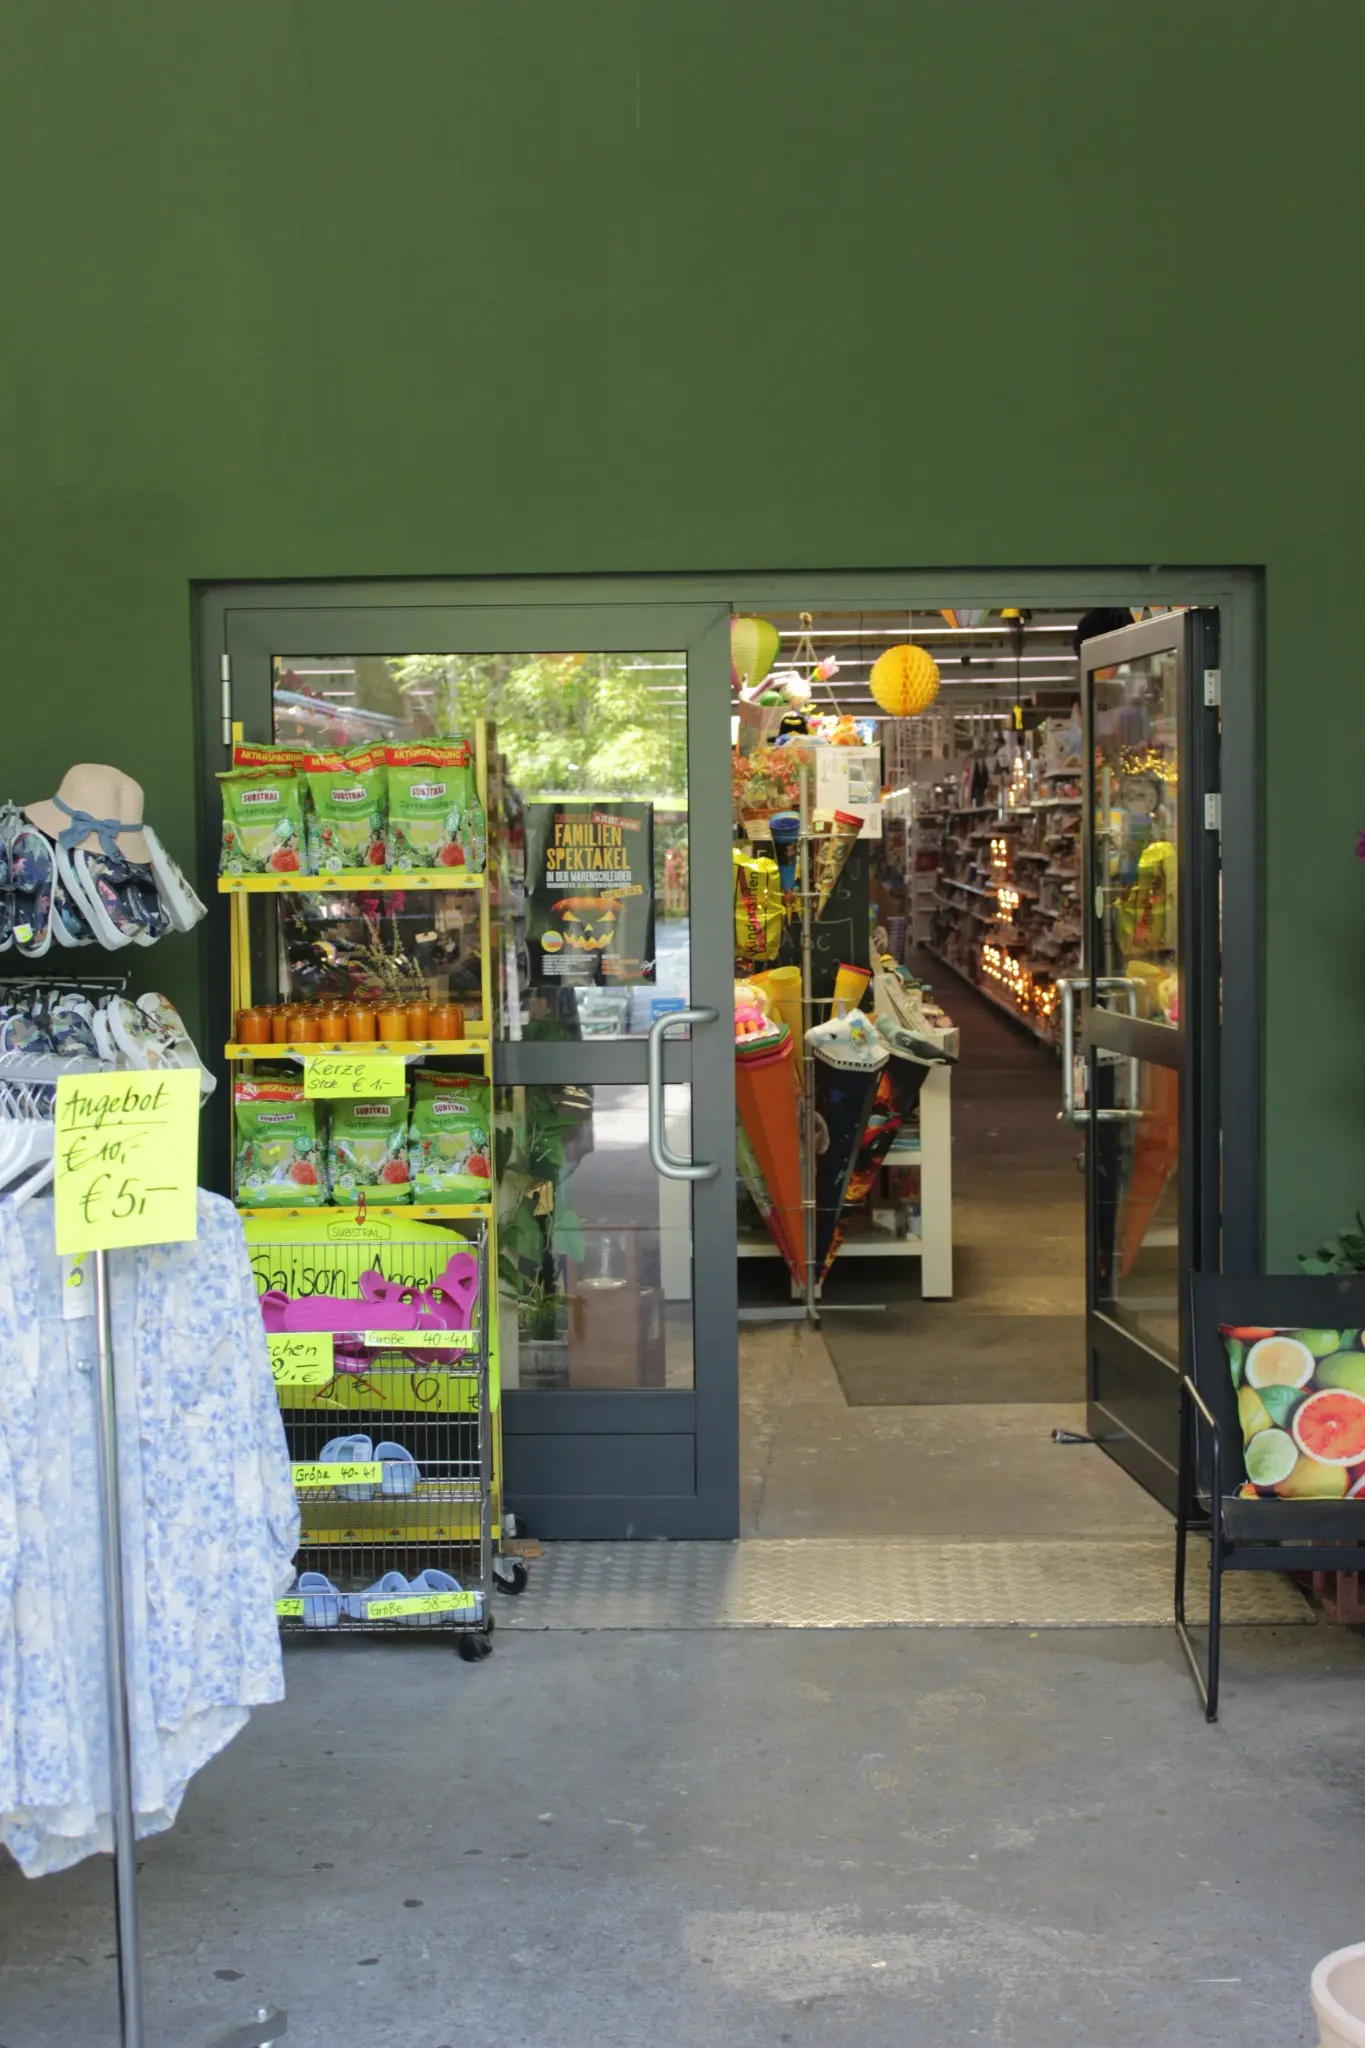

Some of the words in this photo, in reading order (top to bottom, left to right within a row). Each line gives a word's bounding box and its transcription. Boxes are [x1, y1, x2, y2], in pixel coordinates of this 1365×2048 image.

[243, 793, 278, 802] SUBSTRAL
[333, 791, 365, 800] SUBSTRAL
[412, 787, 444, 796] SUBSTRAL
[555, 824, 622, 846] FAMILIEN
[546, 848, 631, 870] SPEKTAKEL
[546, 871, 554, 882] IN
[556, 871, 569, 882] DER
[571, 871, 632, 882] WARENSCHLEUDER
[308, 1058, 366, 1075] Kerze
[352, 1078, 365, 1092] €
[61, 1082, 169, 1129] Angebot
[355, 1107, 389, 1116] SUBSTRAL
[434, 1104, 467, 1113] SUBSTRAL
[79, 1173, 111, 1224] €
[332, 1227, 382, 1238] SUBSTRAL
[266, 1339, 318, 1357] chen
[418, 1593, 470, 1612] 38-39
